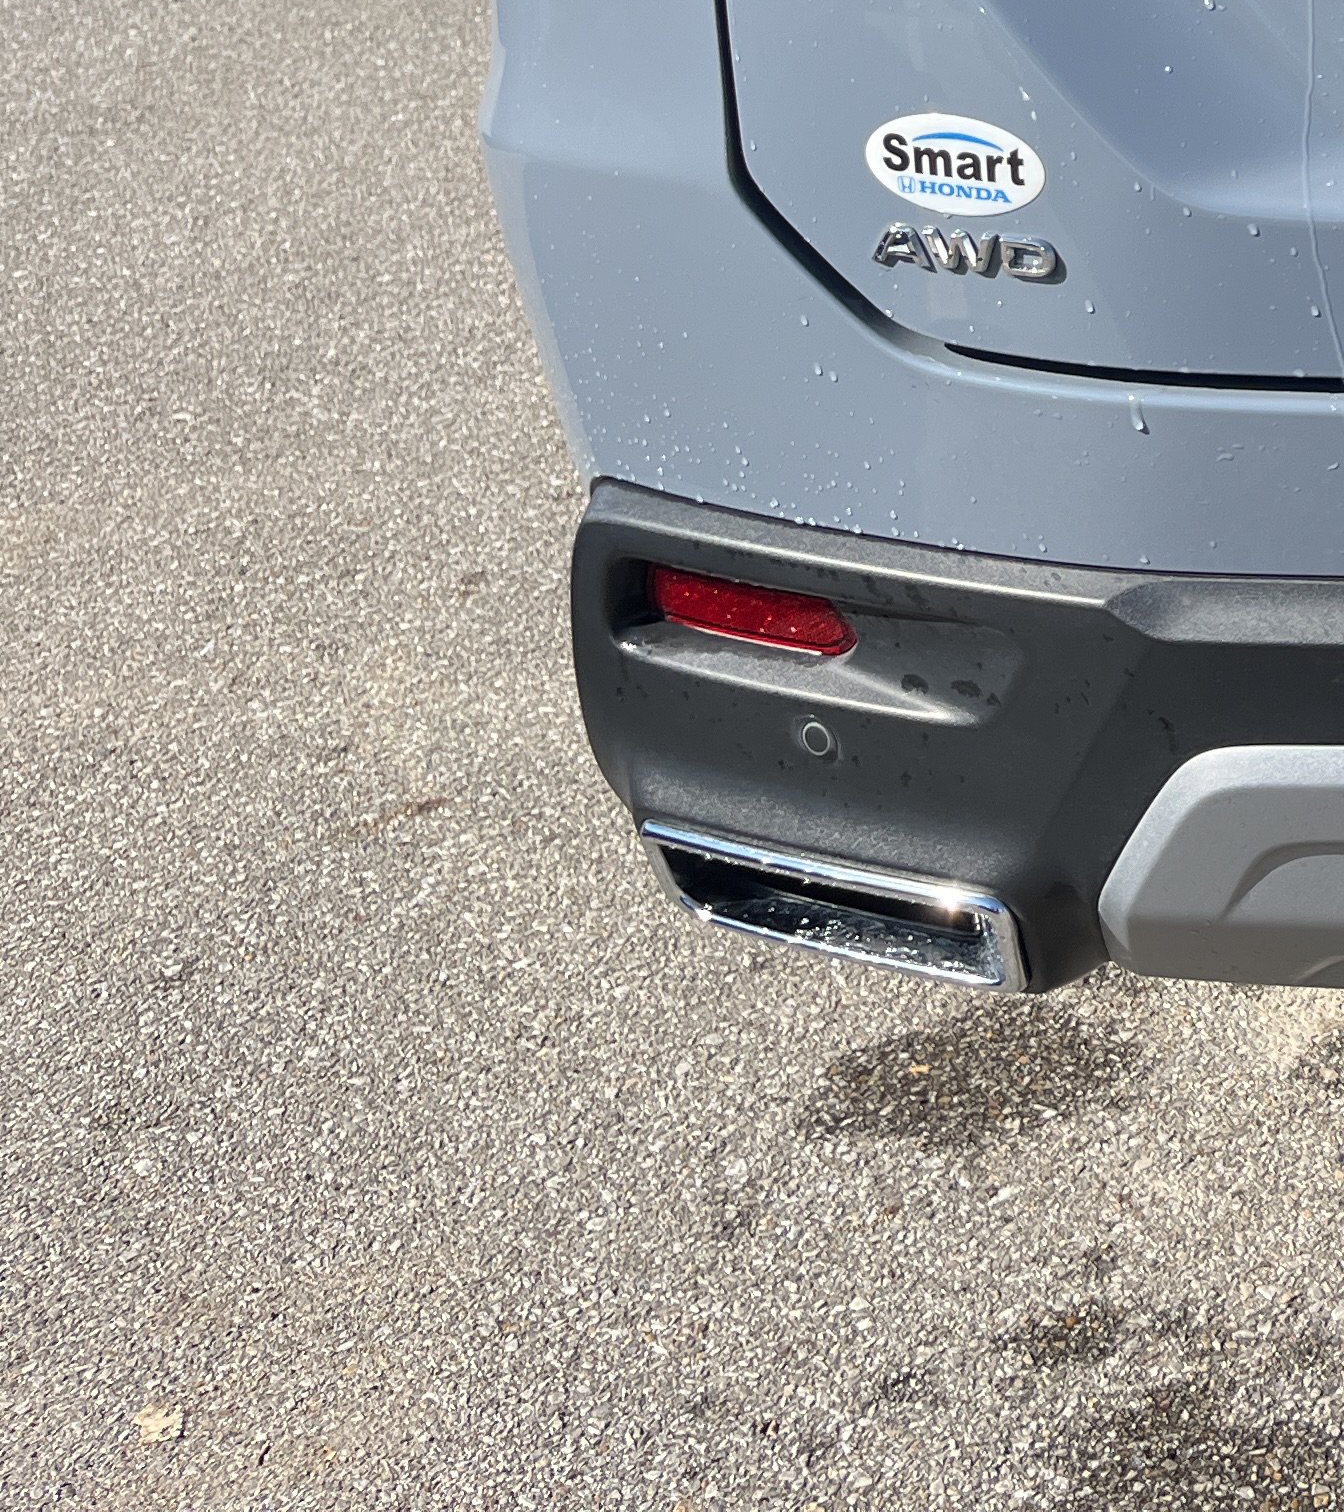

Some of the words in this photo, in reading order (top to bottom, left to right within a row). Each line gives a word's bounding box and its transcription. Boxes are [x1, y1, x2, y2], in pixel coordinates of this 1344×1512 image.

[882, 133, 1025, 186] Smart
[919, 180, 1012, 204] HONDA
[872, 222, 1060, 279] AWD
